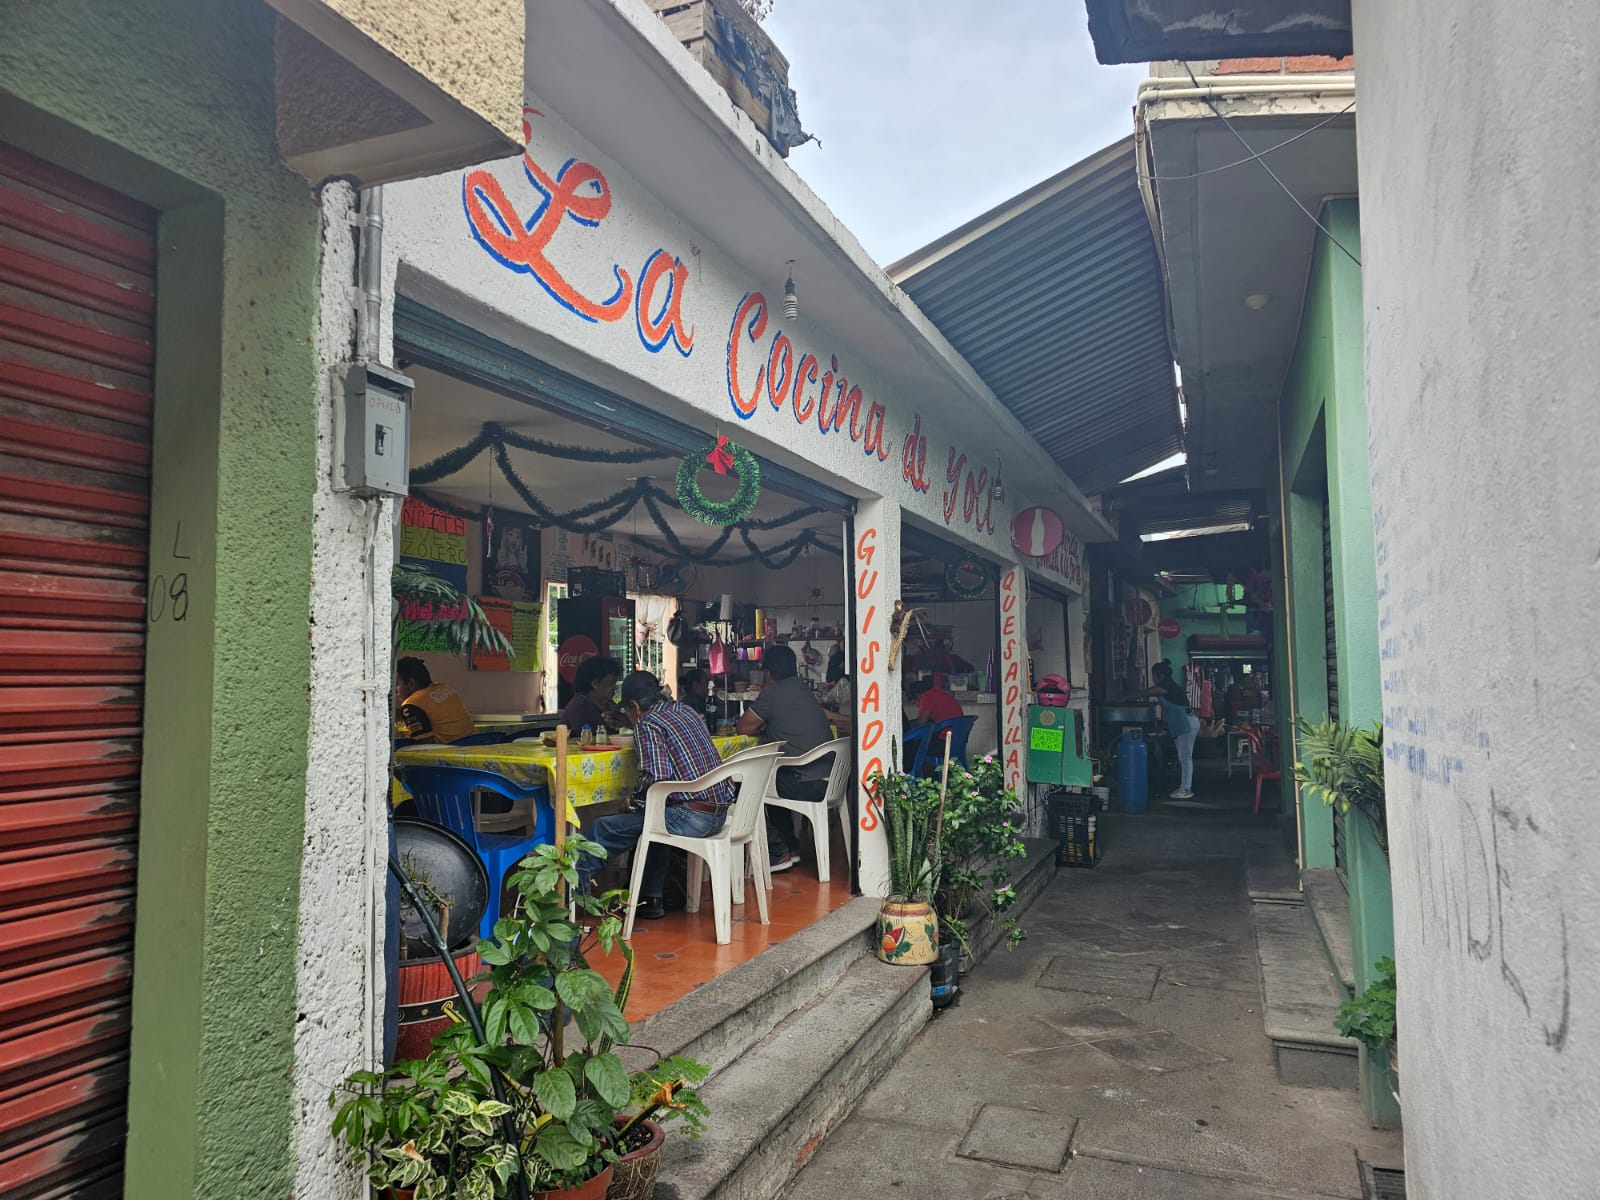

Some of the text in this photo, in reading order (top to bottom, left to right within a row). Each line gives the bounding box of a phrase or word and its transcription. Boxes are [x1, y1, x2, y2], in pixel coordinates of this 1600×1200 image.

[463, 104, 694, 358] La
[727, 291, 892, 462] Cocina
[902, 410, 931, 494] de
[401, 540, 468, 564] ZOLERO
[857, 528, 884, 832] GUISADOS
[1002, 570, 1023, 791] QUESADILLAS
